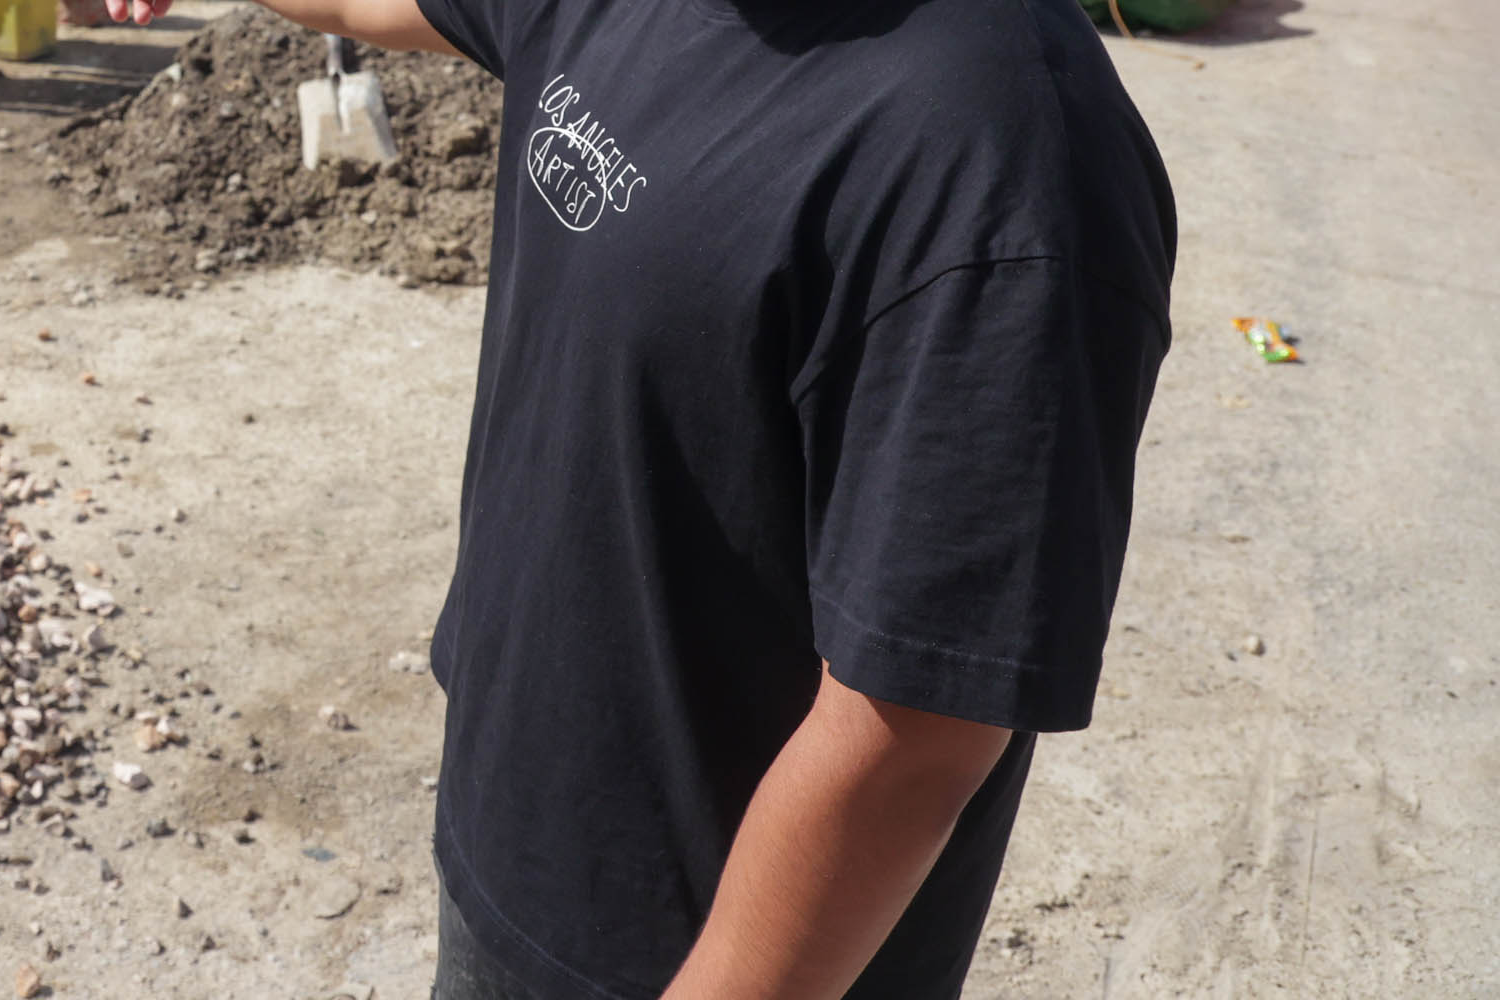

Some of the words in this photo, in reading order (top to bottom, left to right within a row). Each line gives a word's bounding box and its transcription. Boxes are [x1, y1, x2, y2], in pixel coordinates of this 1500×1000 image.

[538, 73, 581, 127] LOS
[531, 134, 597, 225] ARTIST
[558, 111, 647, 213] ANGELES
